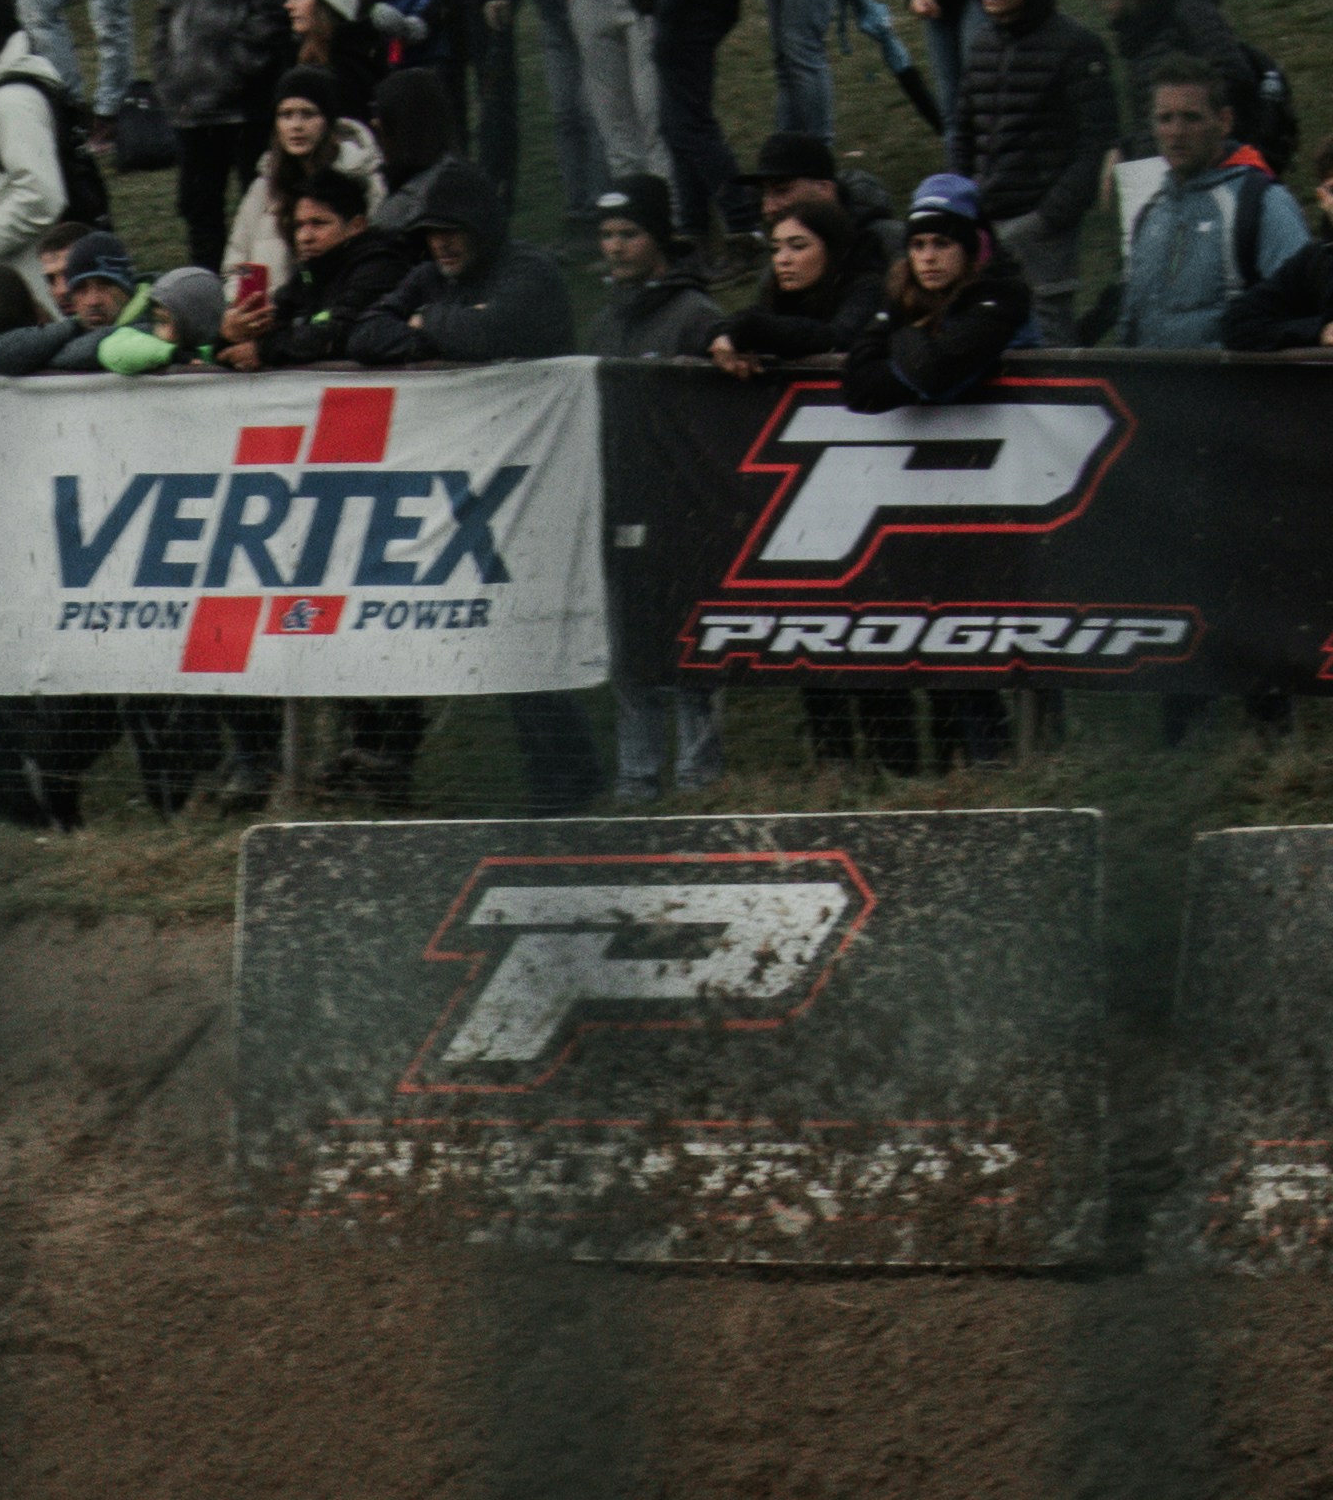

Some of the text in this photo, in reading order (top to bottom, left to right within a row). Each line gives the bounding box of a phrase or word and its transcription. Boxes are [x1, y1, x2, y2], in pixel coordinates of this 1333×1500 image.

[53, 461, 532, 588] VERTEX
[55, 600, 189, 632] PISTON
[350, 597, 492, 630] POWER
[699, 615, 1188, 656] PROGRIP
